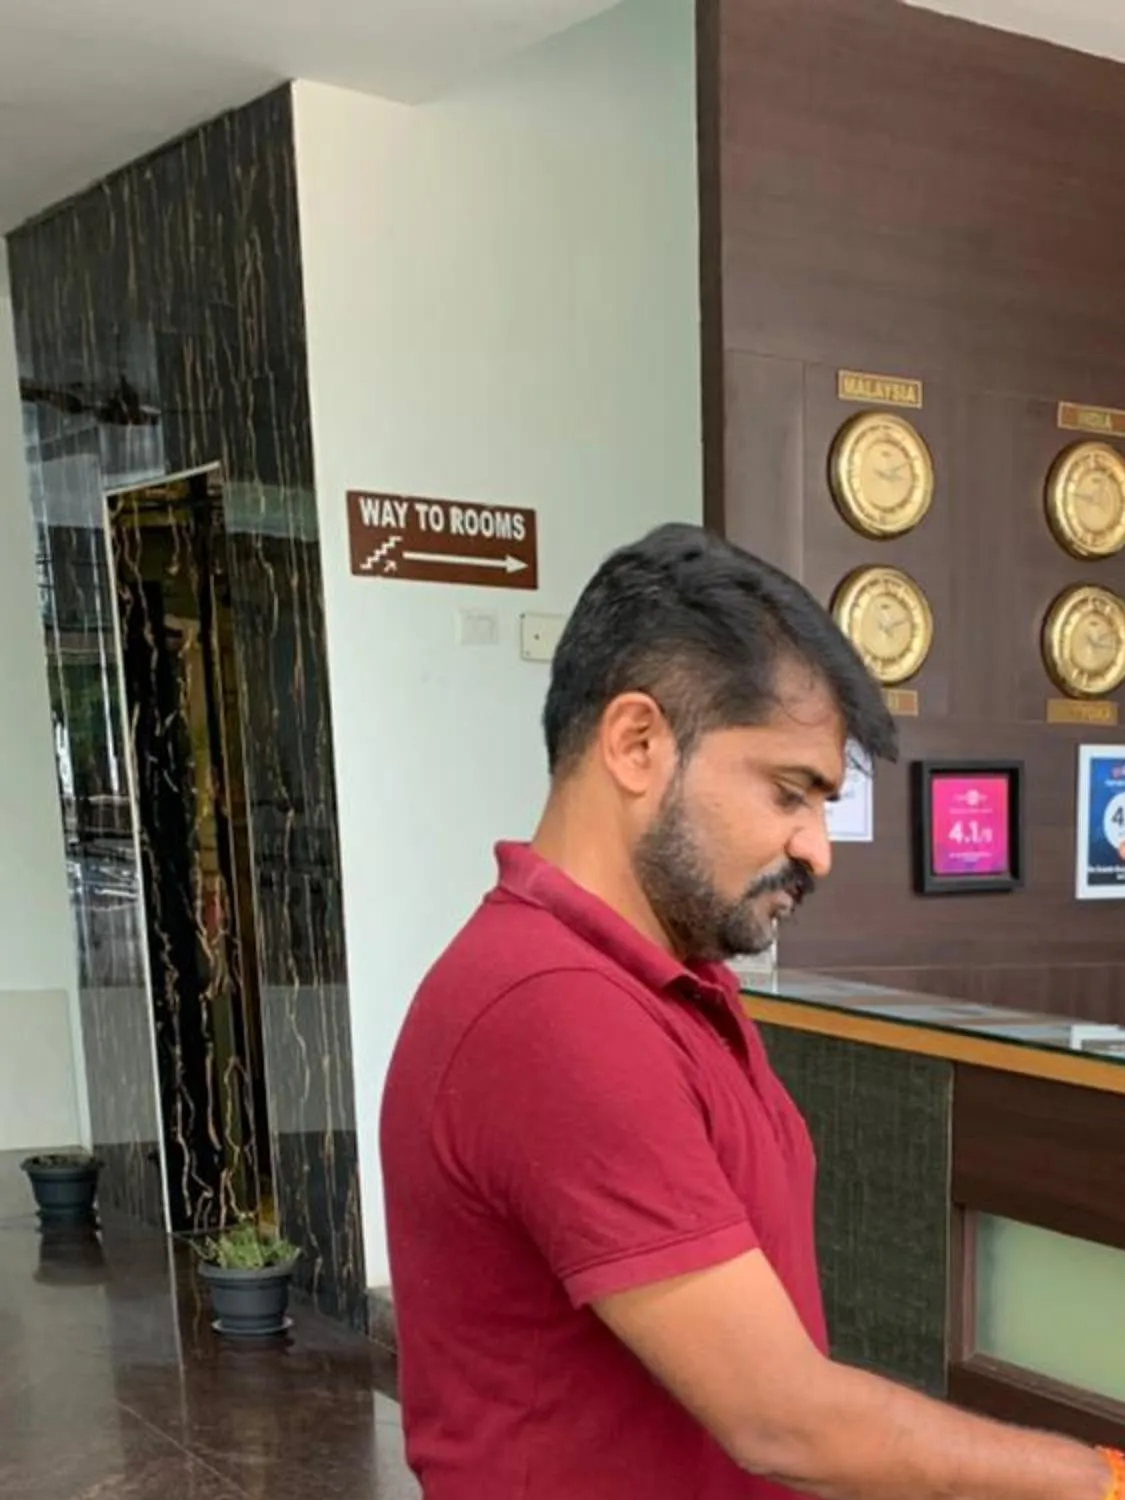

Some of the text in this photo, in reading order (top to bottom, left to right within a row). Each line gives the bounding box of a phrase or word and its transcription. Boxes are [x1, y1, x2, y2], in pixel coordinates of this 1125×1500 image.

[843, 375, 917, 403] MALAYSIA
[358, 496, 526, 541] WAY TO ROOMS
